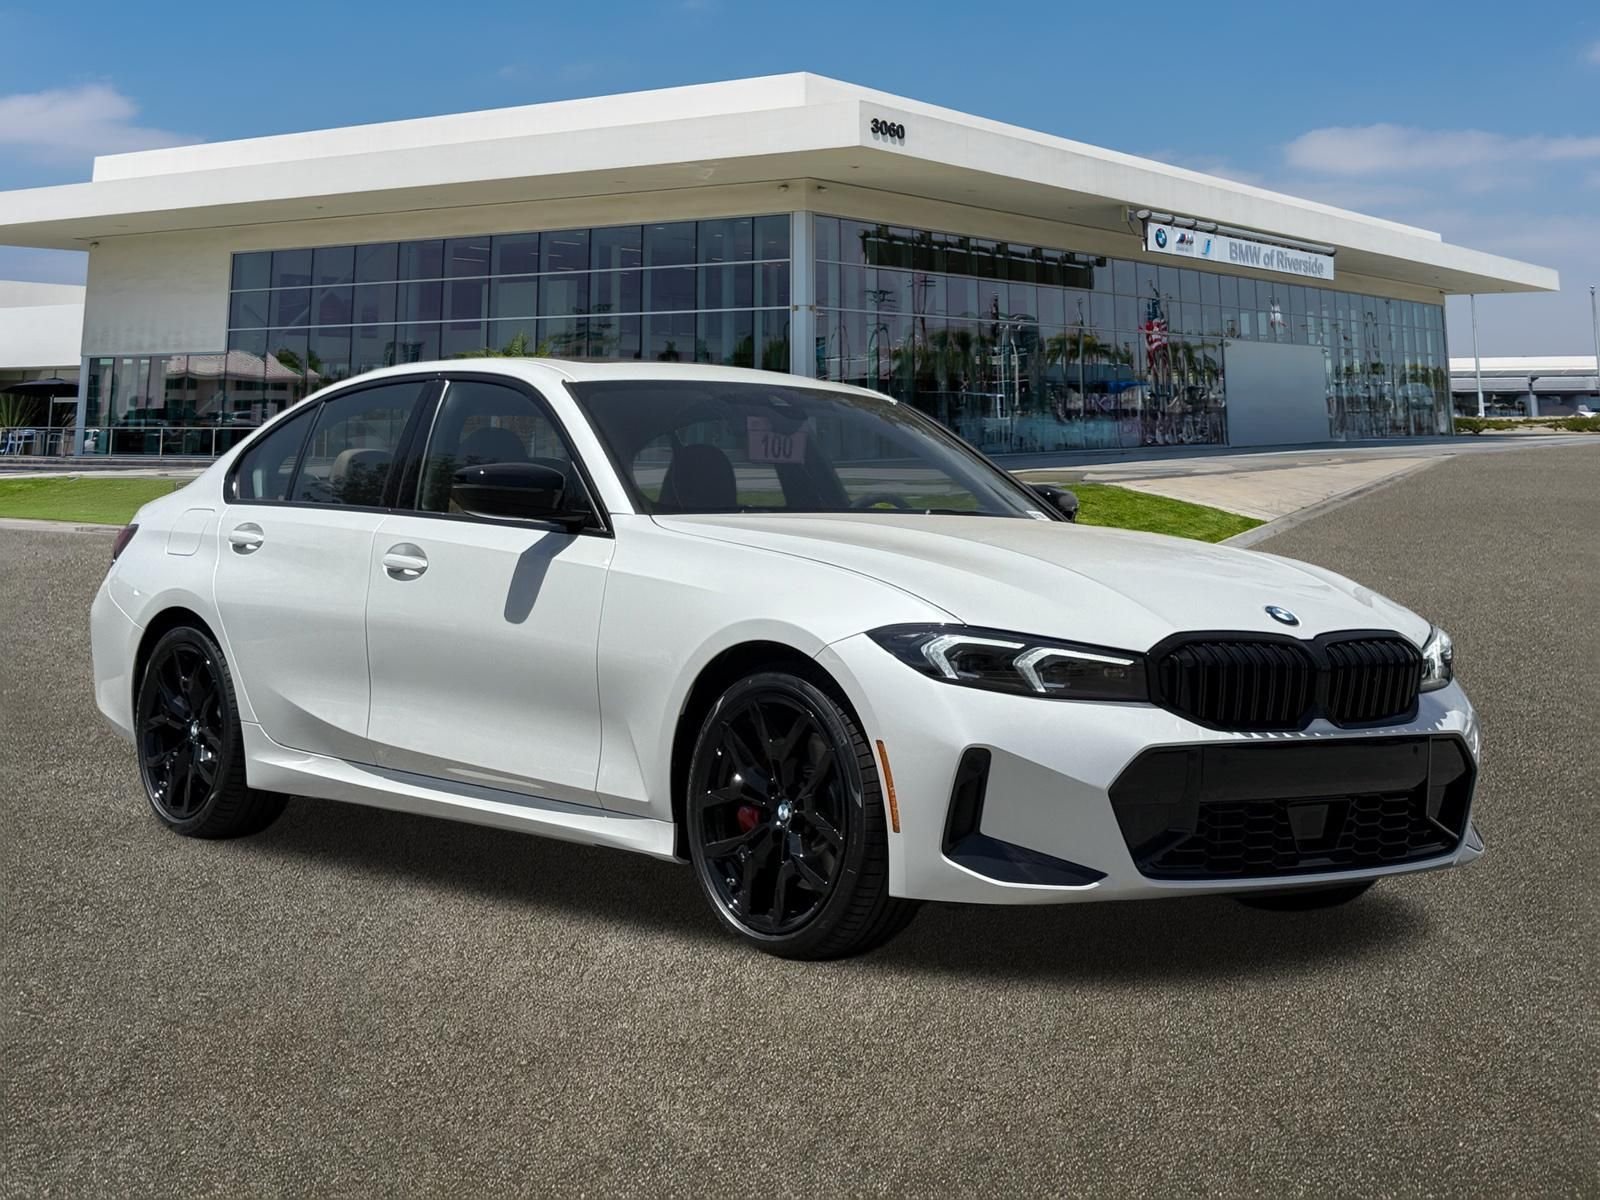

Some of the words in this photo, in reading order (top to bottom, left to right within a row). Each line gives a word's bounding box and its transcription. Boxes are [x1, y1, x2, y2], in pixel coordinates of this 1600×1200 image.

[871, 118, 905, 139] 3060
[1229, 241, 1261, 265] BMW
[1263, 249, 1275, 267] of
[1276, 251, 1324, 275] Riverside
